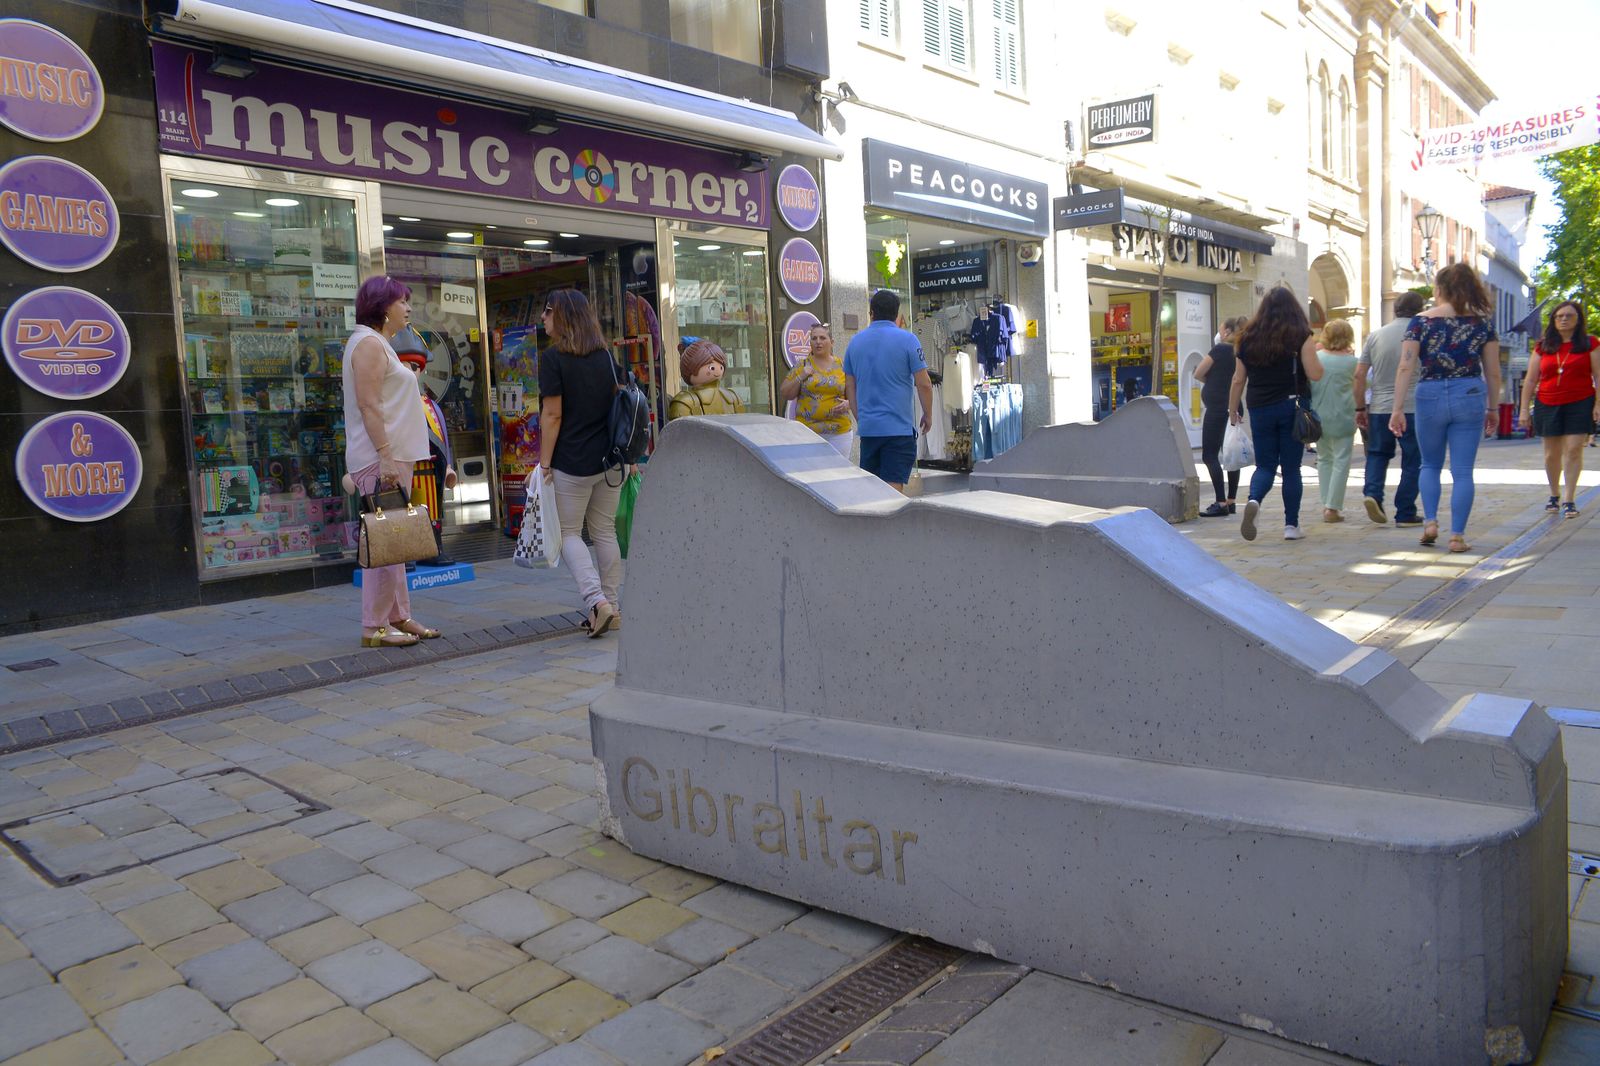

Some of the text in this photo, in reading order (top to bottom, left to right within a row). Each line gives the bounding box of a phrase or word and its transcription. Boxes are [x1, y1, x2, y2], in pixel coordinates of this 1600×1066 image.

[160, 109, 187, 126] 114
[1090, 100, 1152, 130] PERFUMERY
[1486, 106, 1586, 138] MEASURES
[161, 133, 190, 143] STREET
[165, 127, 185, 135] MAIN
[1125, 129, 1144, 137] INDIA
[1461, 143, 1486, 155] SHO
[1489, 124, 1574, 151] RESPONSIBLY
[202, 89, 758, 223] music corner 2
[888, 158, 1038, 210] PEACOCKS
[781, 184, 816, 211] MUSIC
[1060, 202, 1114, 216] PEACOCKS
[1, 190, 109, 238] GAMES
[1169, 222, 1214, 241] STAR OF INDIA
[919, 258, 981, 271] PEACOCKS
[1202, 244, 1243, 273] INDIA
[783, 258, 819, 284] GAMES
[919, 275, 983, 288] QUALITY & VALUE
[315, 281, 357, 291] News Agents
[443, 292, 474, 305] OPEN
[16, 319, 114, 348] DVD
[788, 329, 811, 347] DV
[39, 364, 101, 375] VIDEO
[71, 422, 93, 457] &
[42, 461, 125, 498] MORE
[412, 569, 461, 589] playmobil
[622, 756, 918, 886] Gibraltar
